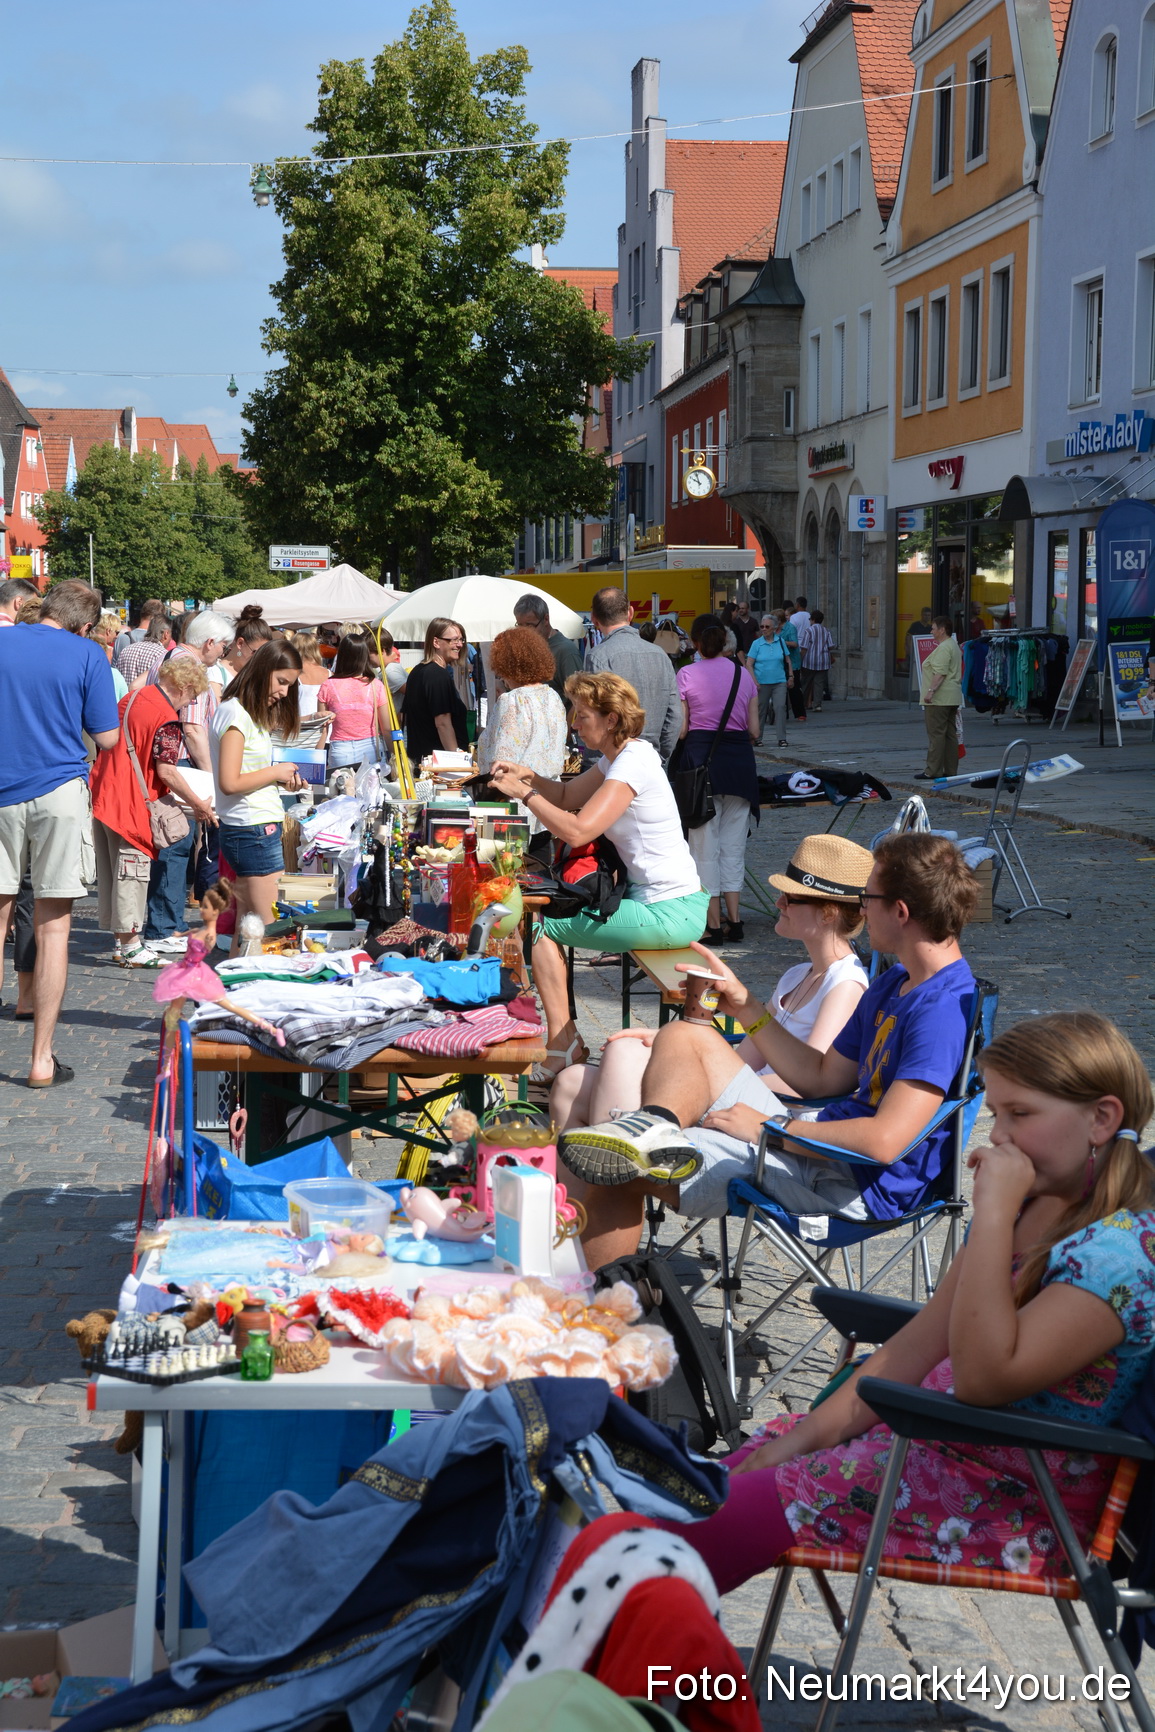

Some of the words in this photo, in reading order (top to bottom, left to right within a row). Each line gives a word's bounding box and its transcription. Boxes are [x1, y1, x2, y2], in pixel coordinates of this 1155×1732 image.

[1065, 421, 1107, 457] mister
[1112, 410, 1144, 453] lady
[1113, 549, 1146, 571] 1&1
[1129, 650, 1142, 658] DSL
[815, 882, 844, 894] Mercedes-Benz
